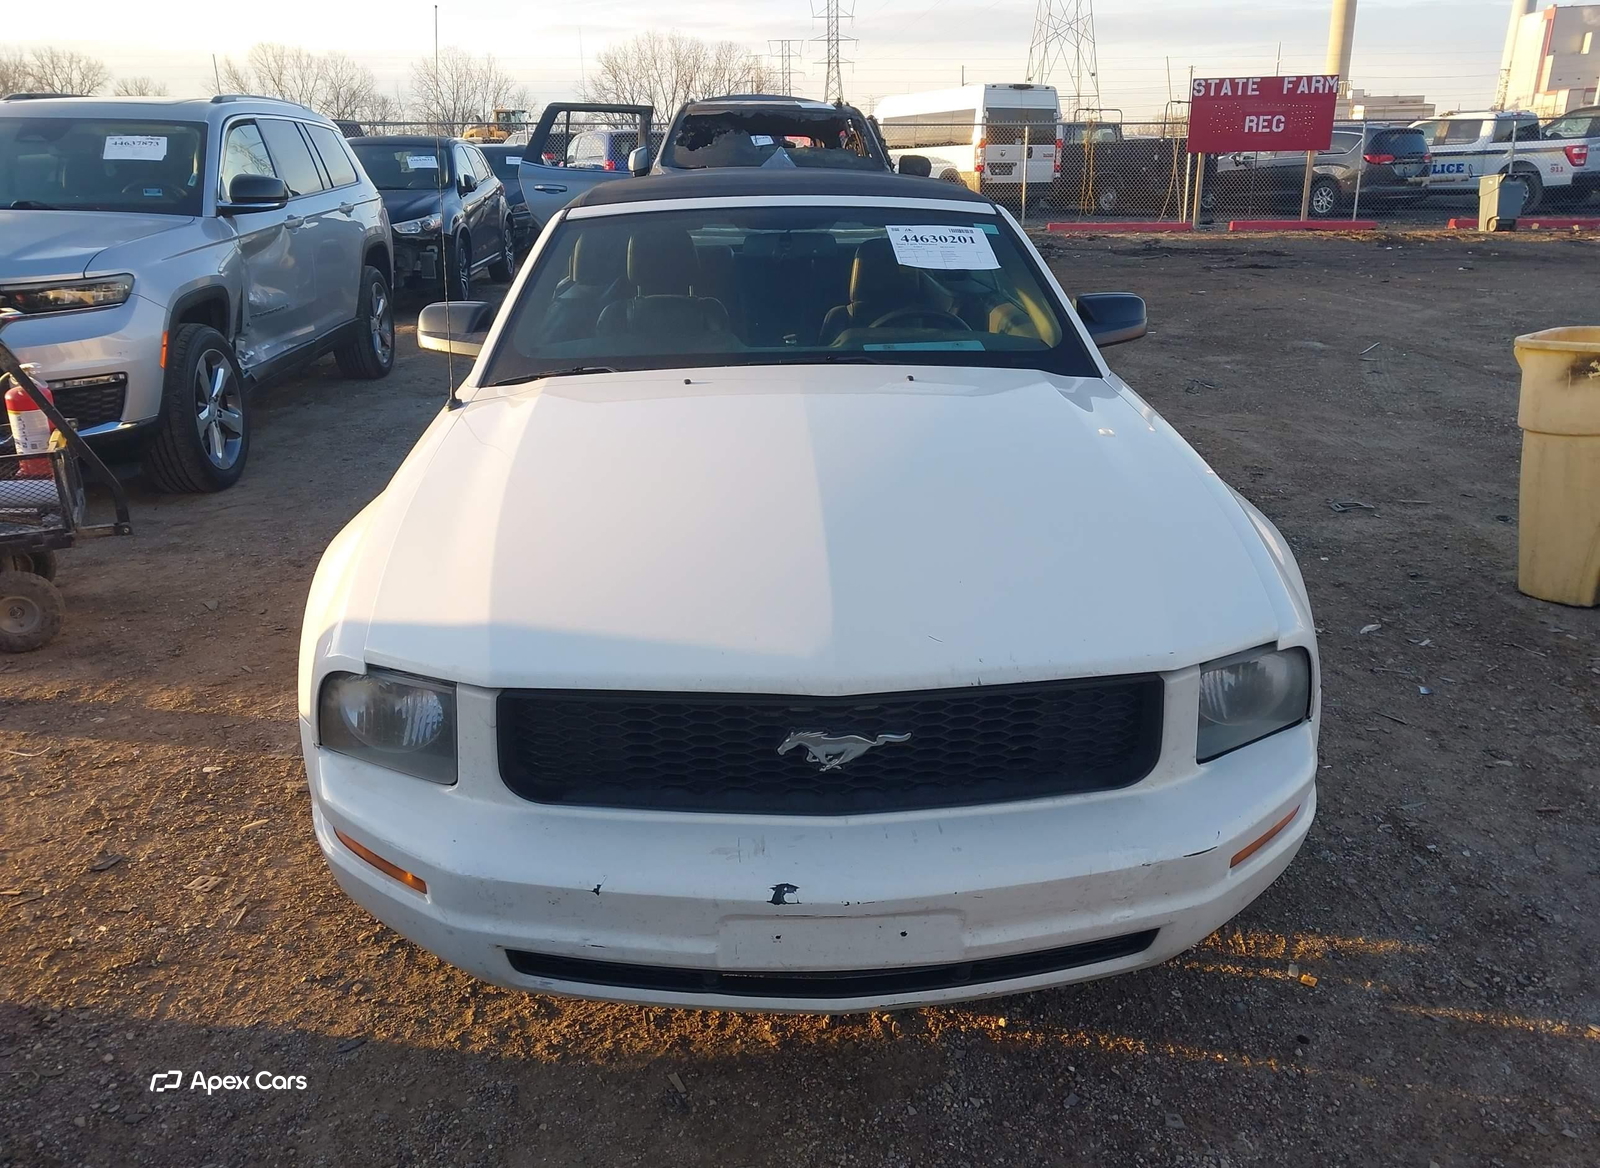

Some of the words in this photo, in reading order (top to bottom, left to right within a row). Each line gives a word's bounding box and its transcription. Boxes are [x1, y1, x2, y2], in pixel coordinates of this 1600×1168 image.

[1193, 78, 1261, 97] STATE
[1283, 76, 1339, 94] FARM
[1244, 115, 1286, 133] REG
[1431, 163, 1465, 174] LICE
[900, 234, 977, 244] 44630201
